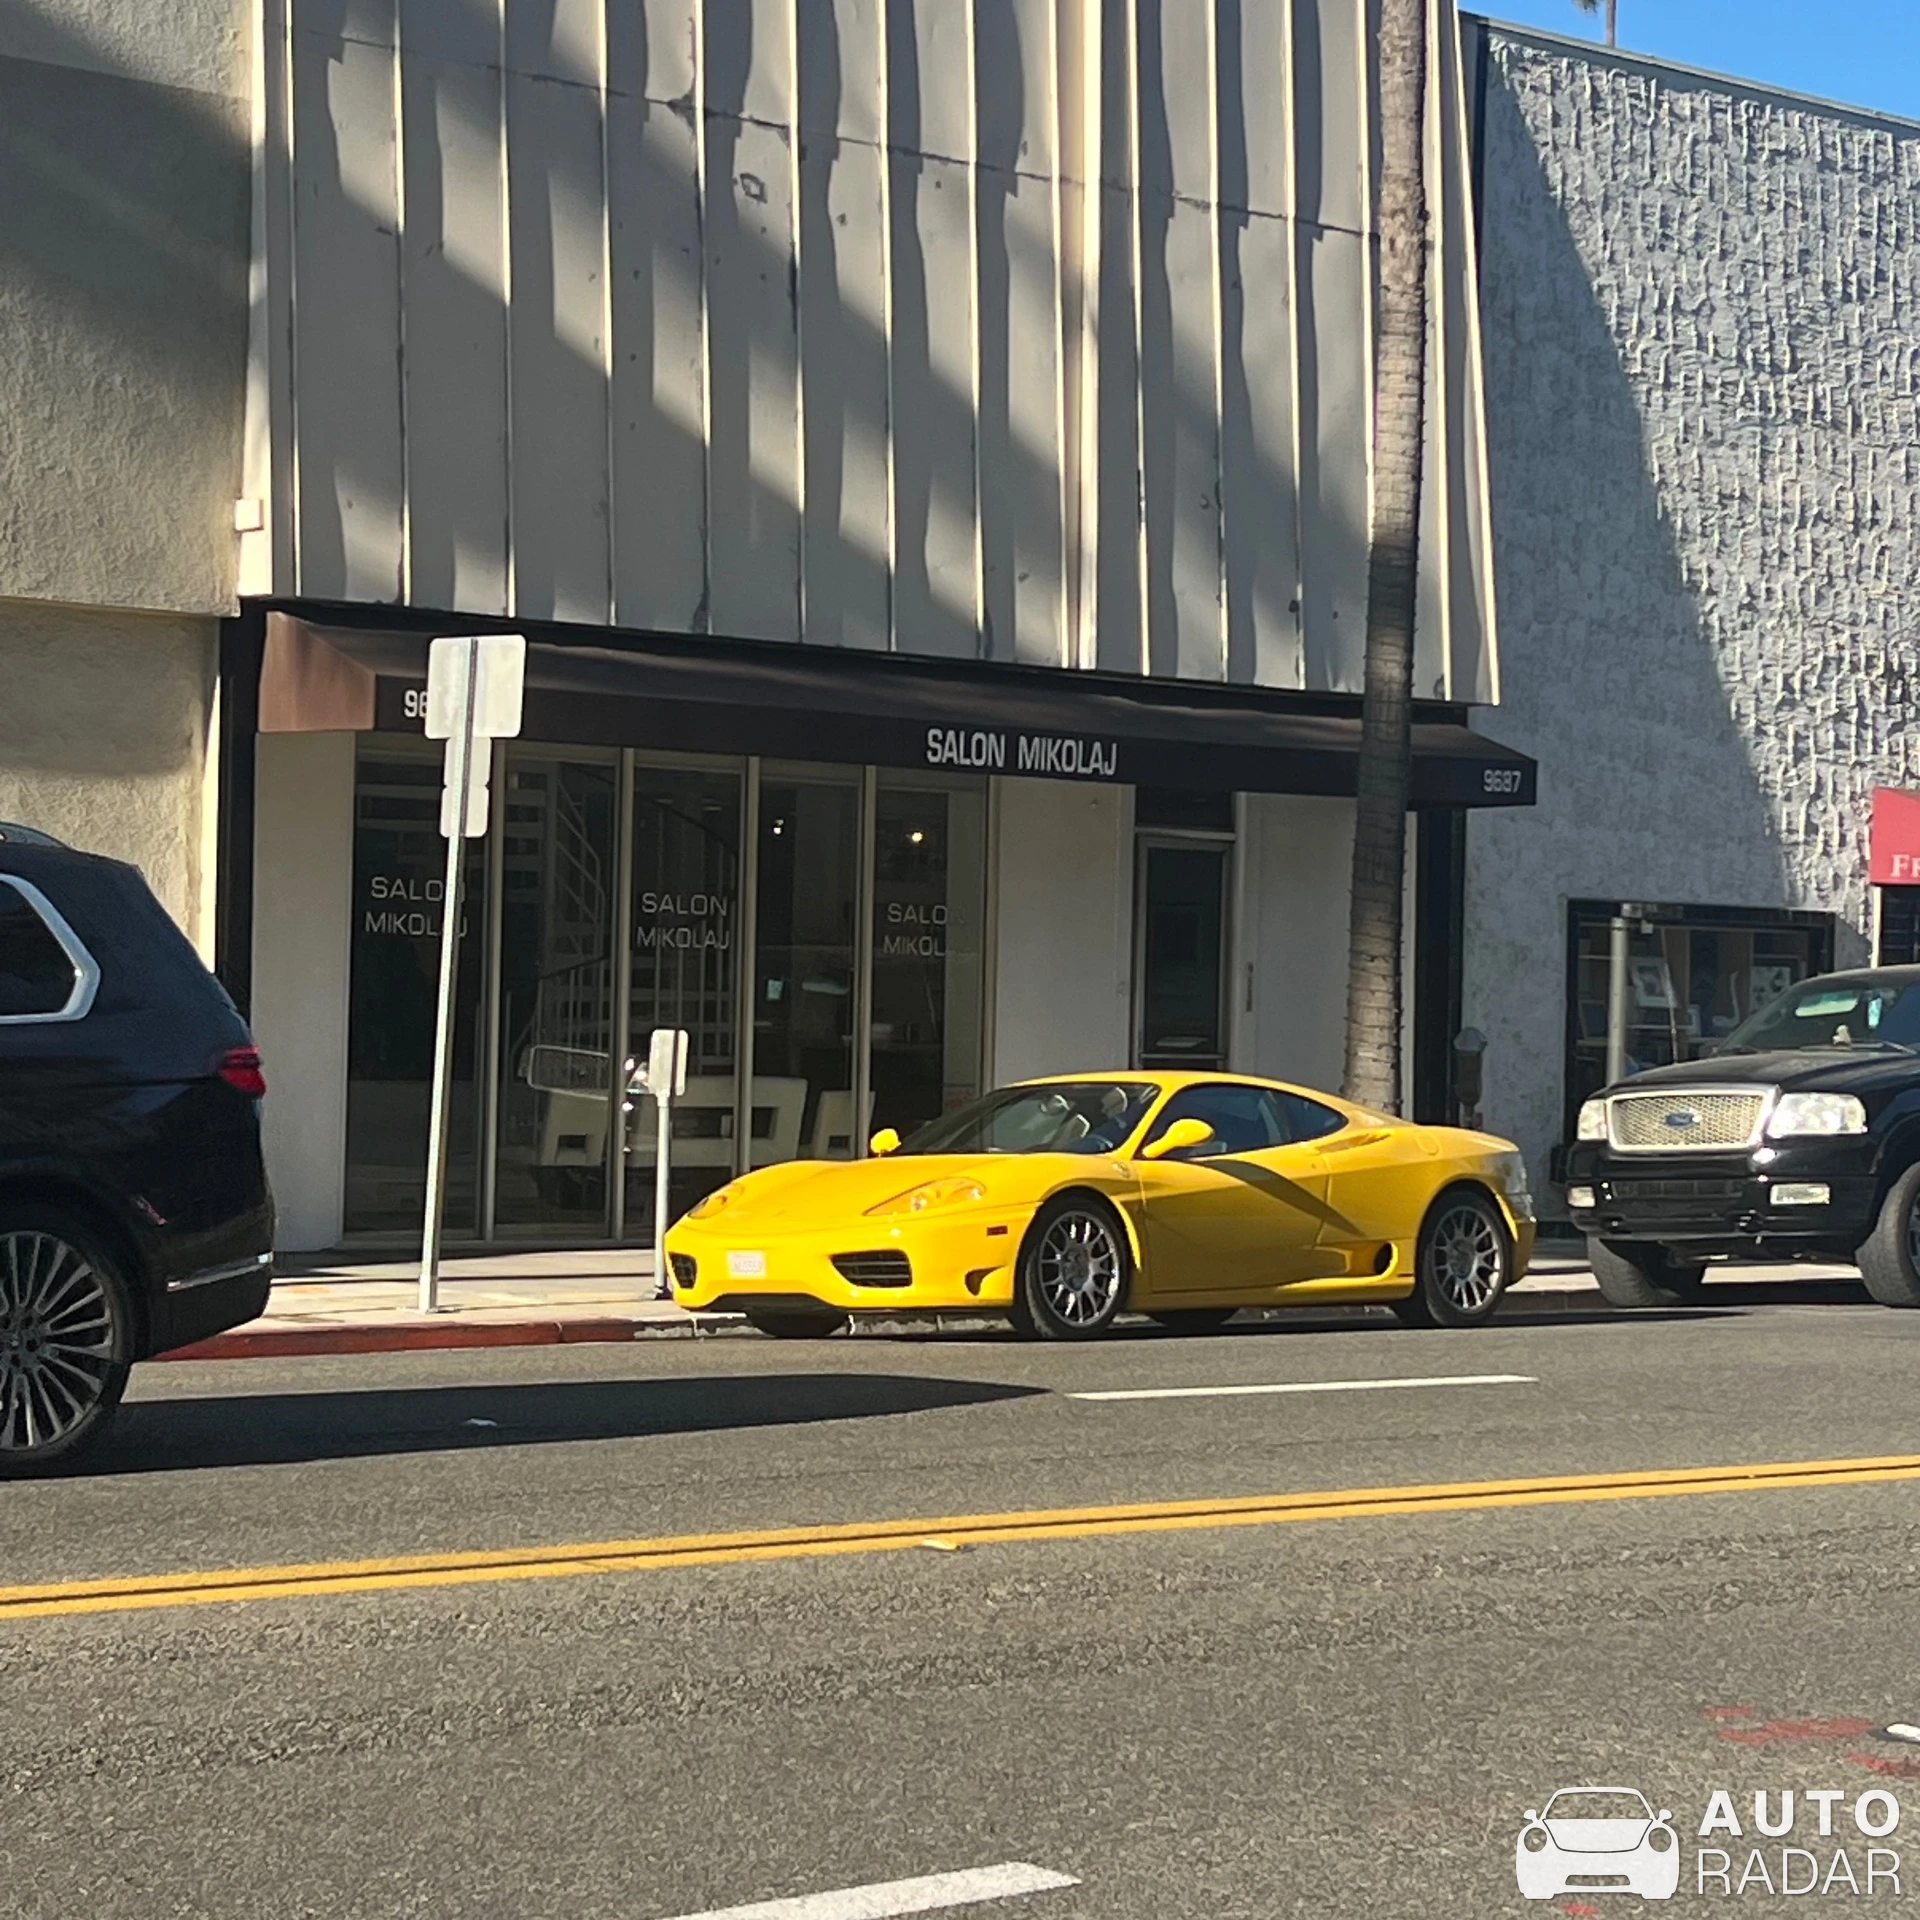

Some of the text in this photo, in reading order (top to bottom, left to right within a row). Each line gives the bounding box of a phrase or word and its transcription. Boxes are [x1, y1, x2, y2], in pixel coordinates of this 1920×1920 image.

[403, 689, 427, 718] 96
[926, 728, 1117, 776] SALON MIKOLAJ
[641, 892, 728, 916] SALON
[887, 902, 965, 925] SALO
[365, 911, 468, 938] MIKOLJ
[637, 926, 730, 950] MIKOLAJ
[882, 934, 948, 957] MIKOL
